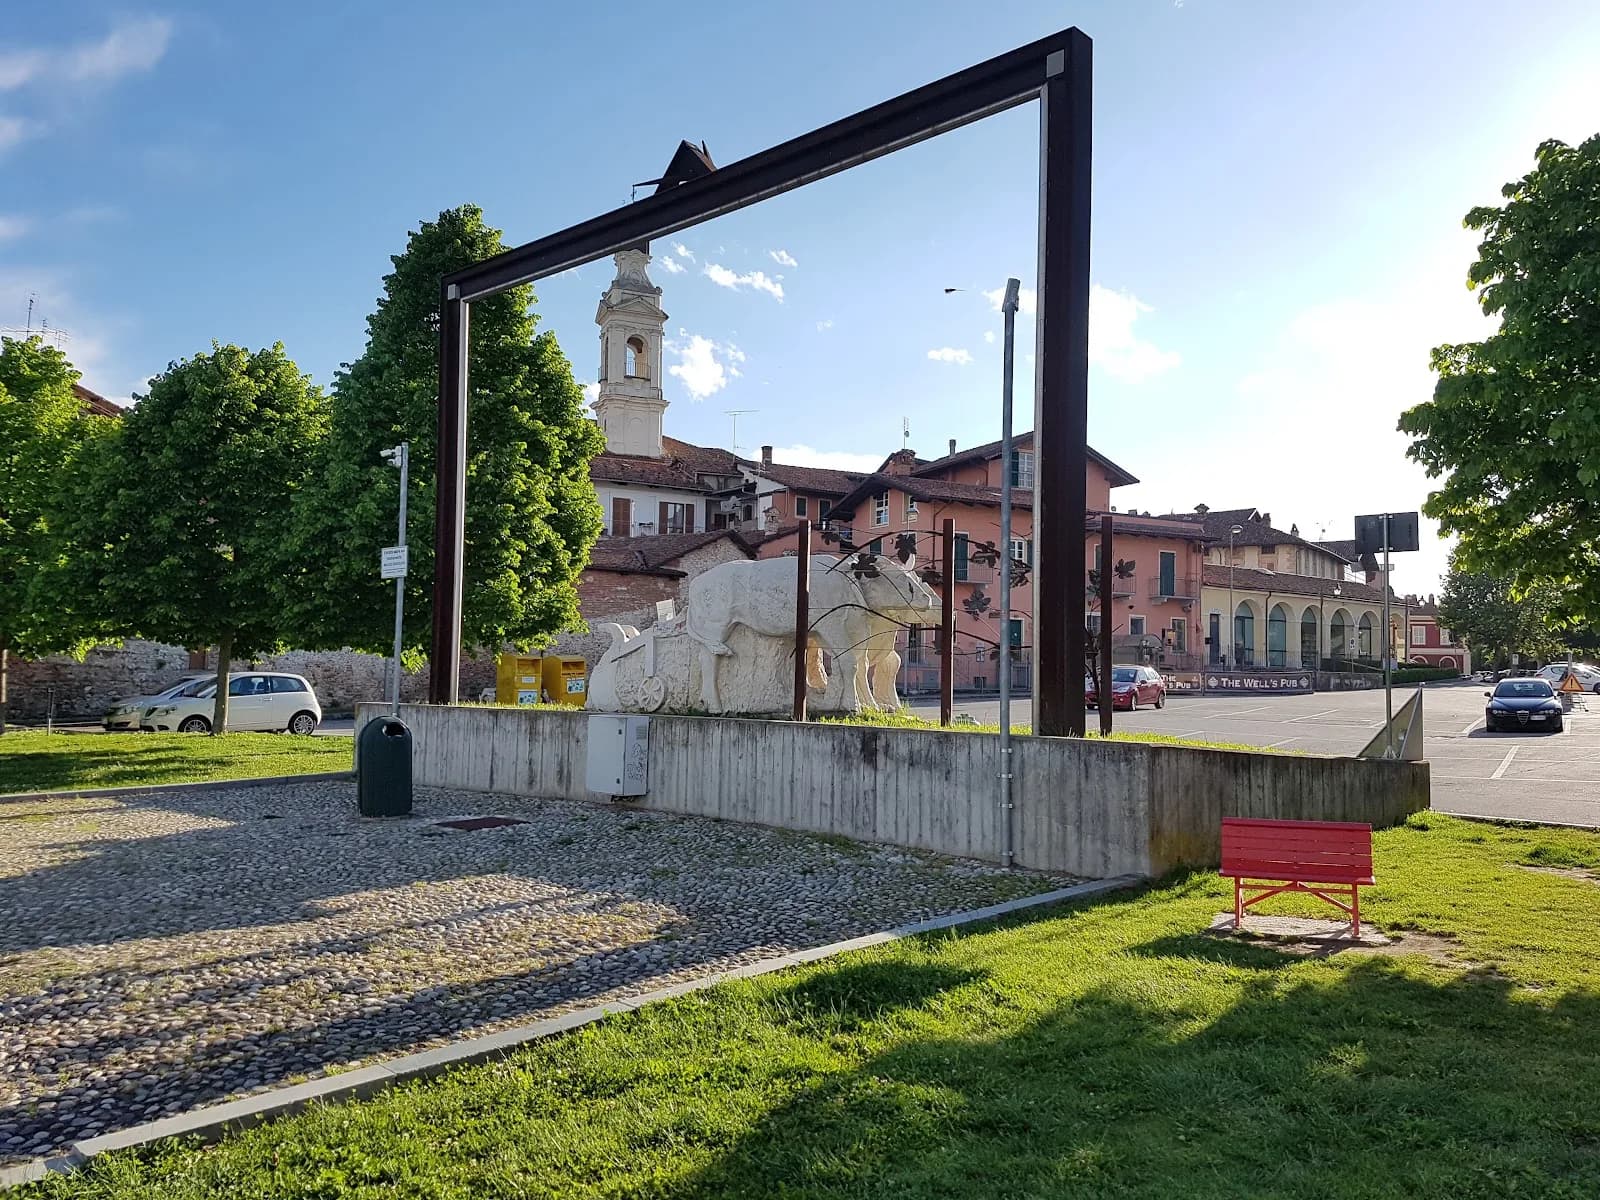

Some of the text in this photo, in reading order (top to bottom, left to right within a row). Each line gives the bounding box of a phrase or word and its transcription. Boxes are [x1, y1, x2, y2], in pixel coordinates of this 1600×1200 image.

[1176, 681, 1191, 689] PUB
[1221, 677, 1298, 688] THE WELL'S PUB
